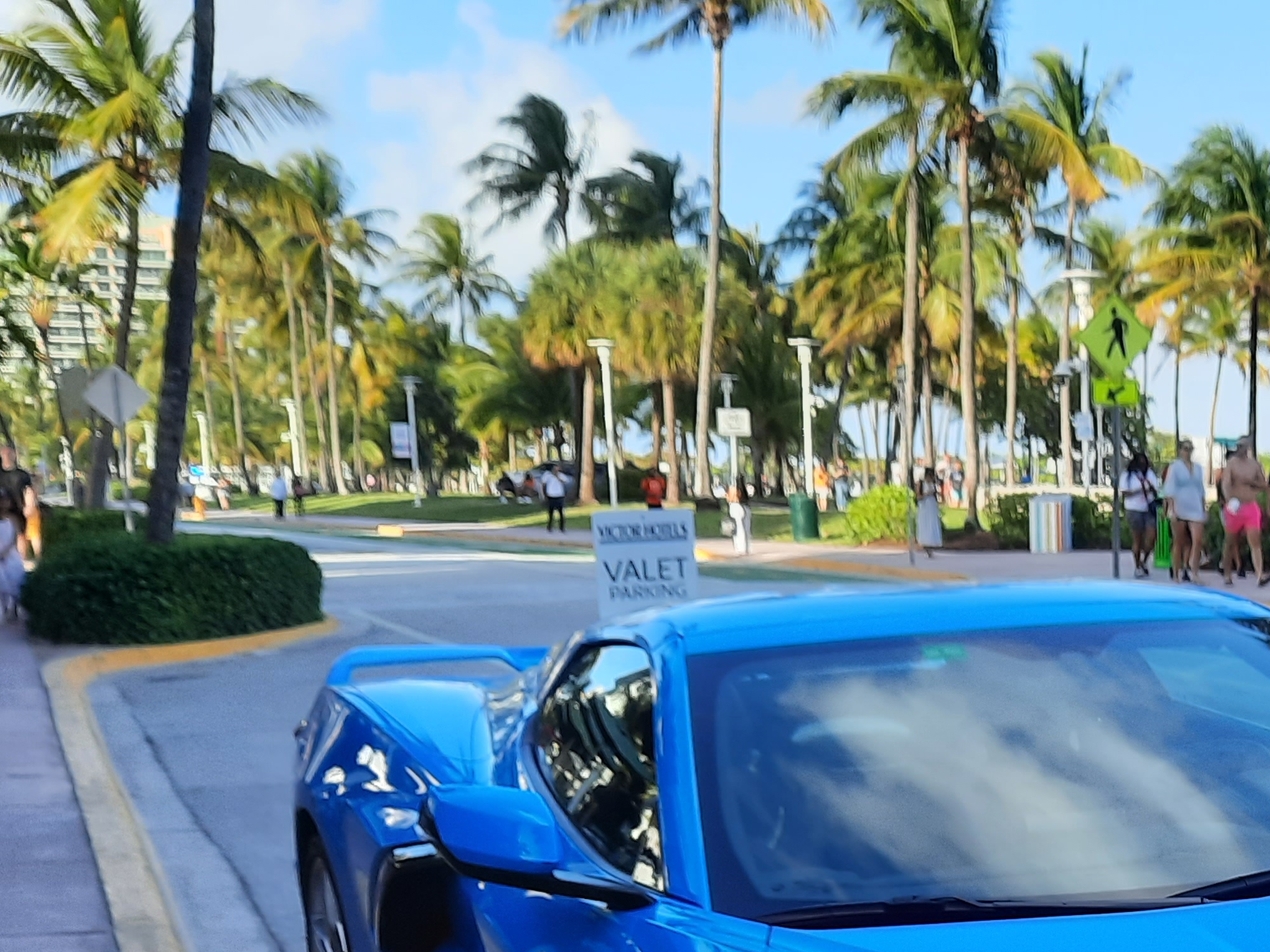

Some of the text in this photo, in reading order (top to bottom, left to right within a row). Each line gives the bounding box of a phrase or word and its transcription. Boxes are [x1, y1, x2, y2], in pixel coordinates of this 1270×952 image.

[596, 523, 641, 540] VICTOR
[602, 556, 688, 583] VALET
[608, 583, 689, 601] PARKING
